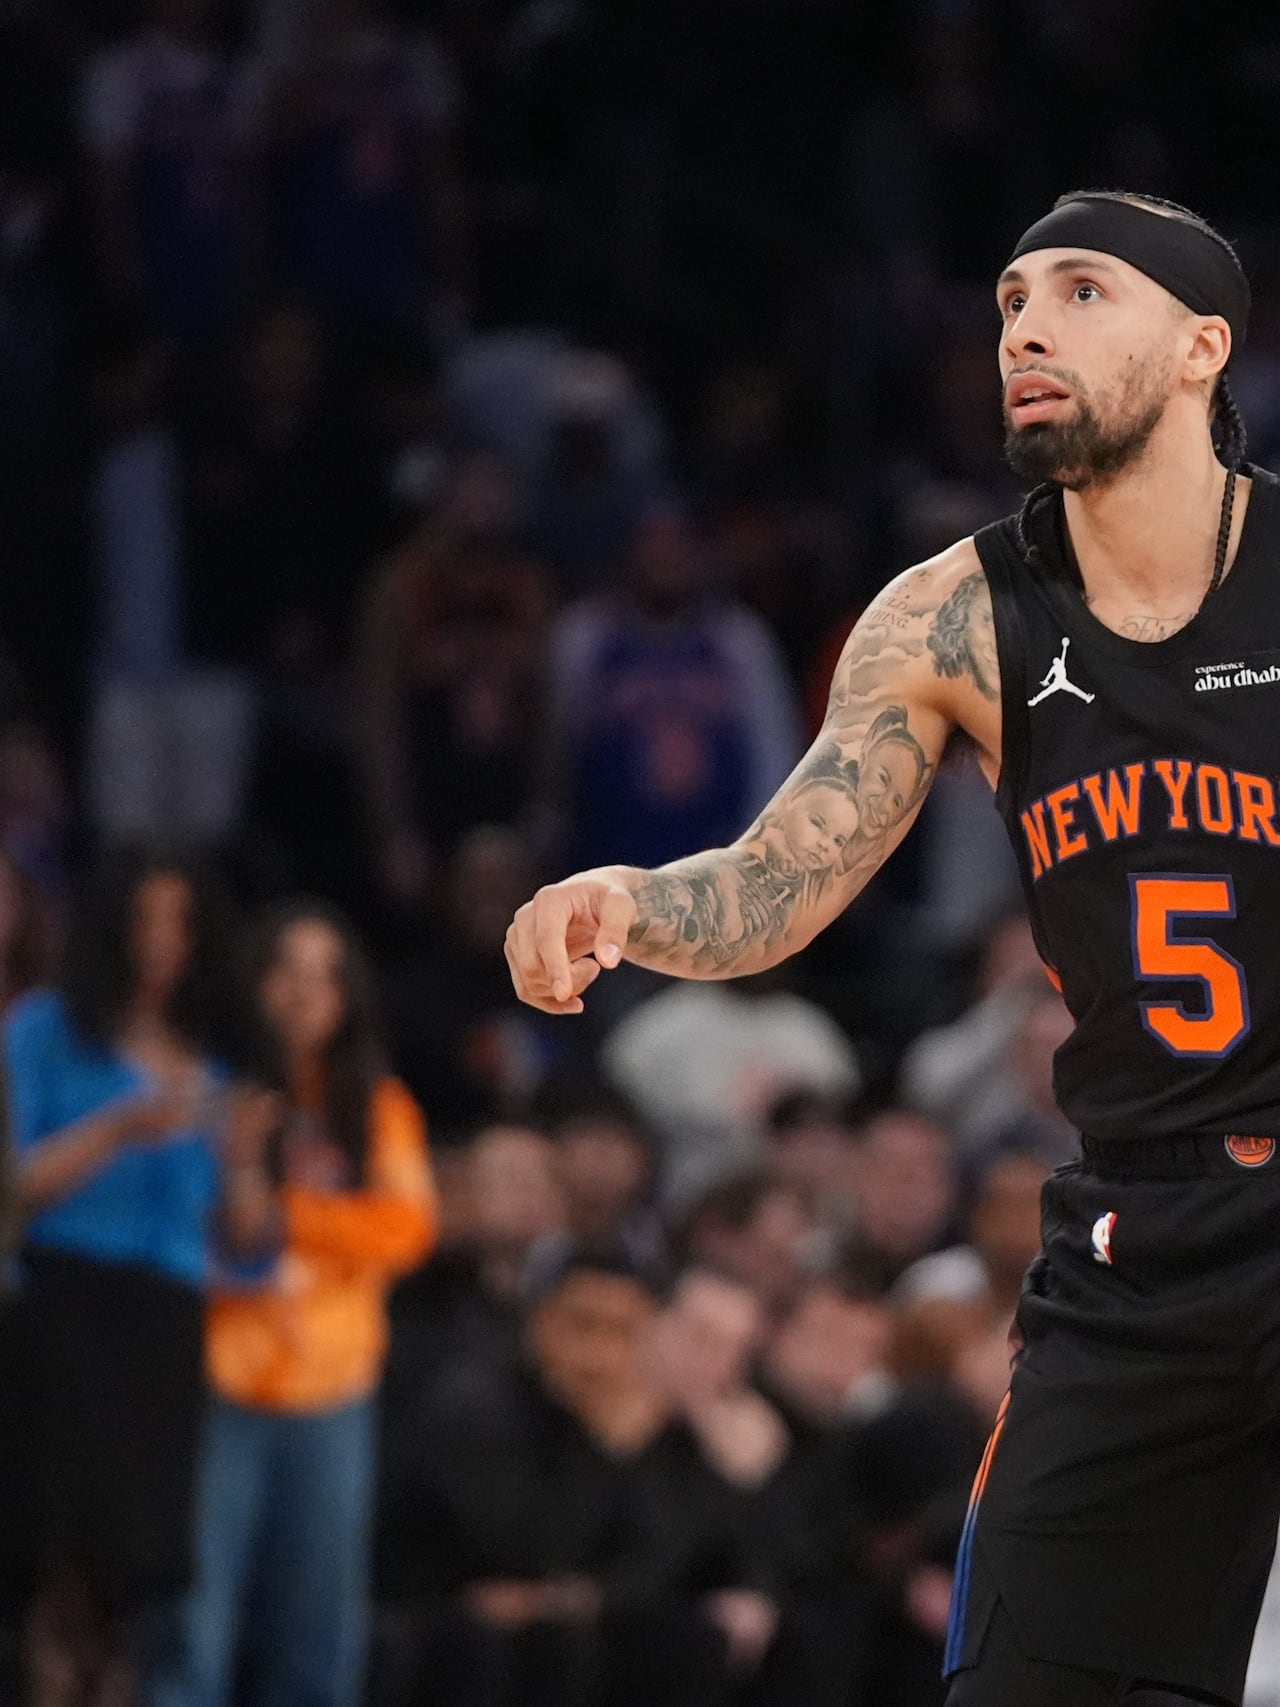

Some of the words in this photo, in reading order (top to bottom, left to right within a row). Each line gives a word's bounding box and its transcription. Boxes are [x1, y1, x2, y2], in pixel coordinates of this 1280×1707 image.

[1194, 674, 1231, 692] abu
[1195, 661, 1245, 674] experience
[1020, 761, 1146, 881] NEW
[1128, 873, 1250, 1059] 5
